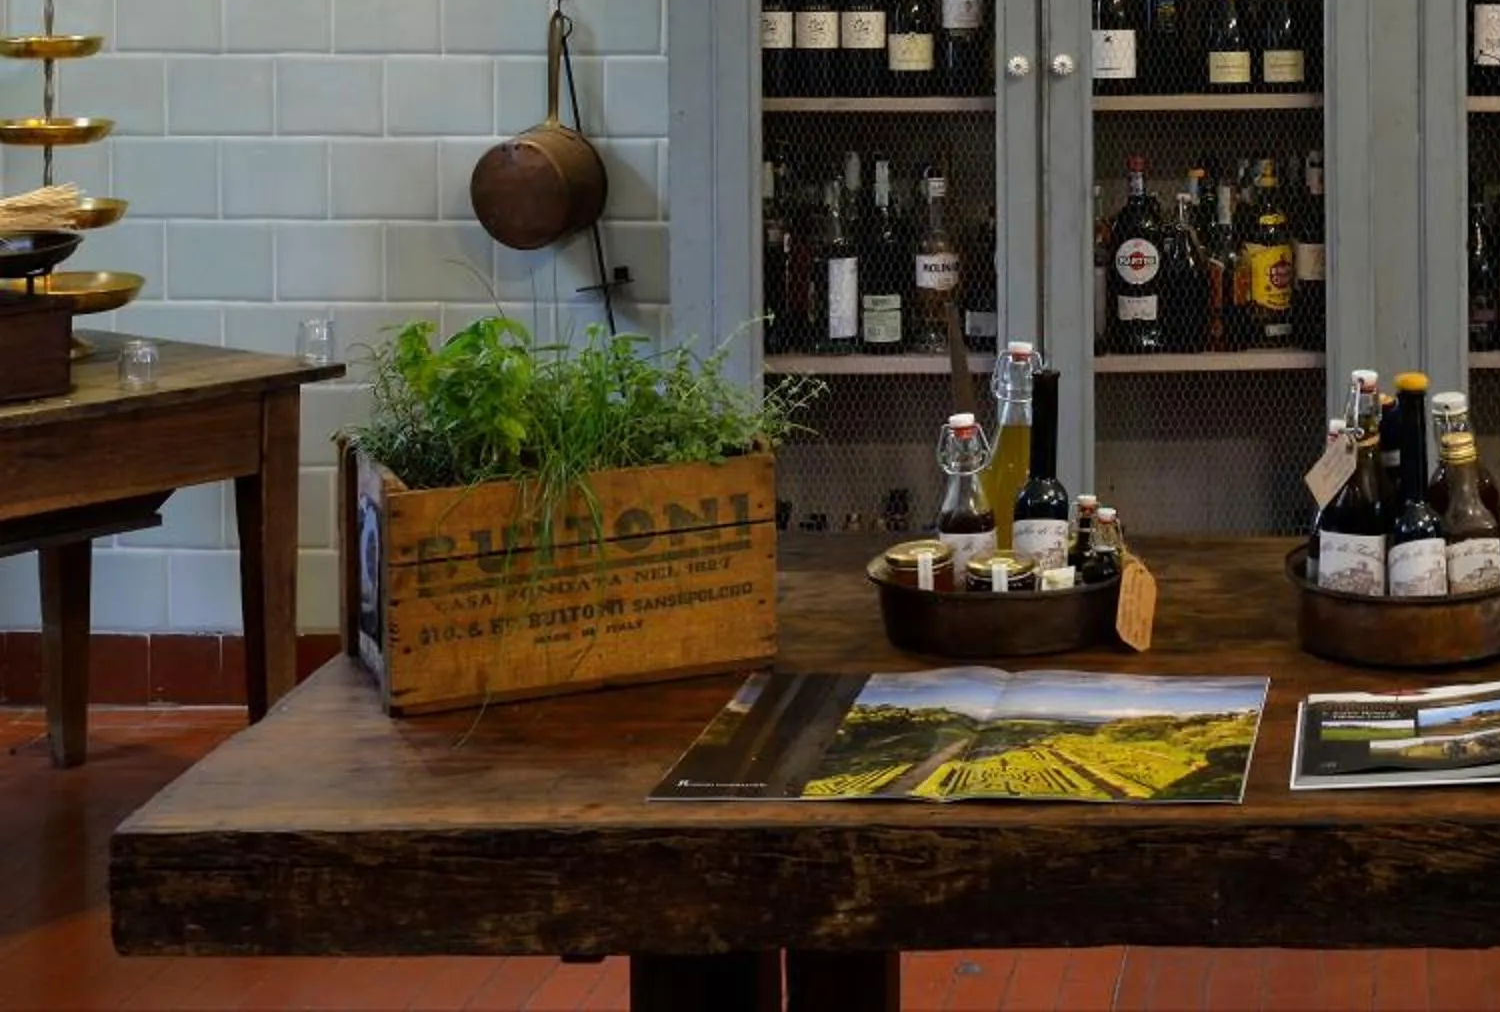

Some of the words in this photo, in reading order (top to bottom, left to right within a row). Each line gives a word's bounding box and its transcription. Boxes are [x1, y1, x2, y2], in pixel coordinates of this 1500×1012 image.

[417, 493, 752, 600] BUITONI
[633, 564, 678, 584] NEL
[528, 597, 625, 629] BUITONI
[632, 580, 754, 614] SANSEPOLCRO
[605, 618, 644, 635] ITALY
